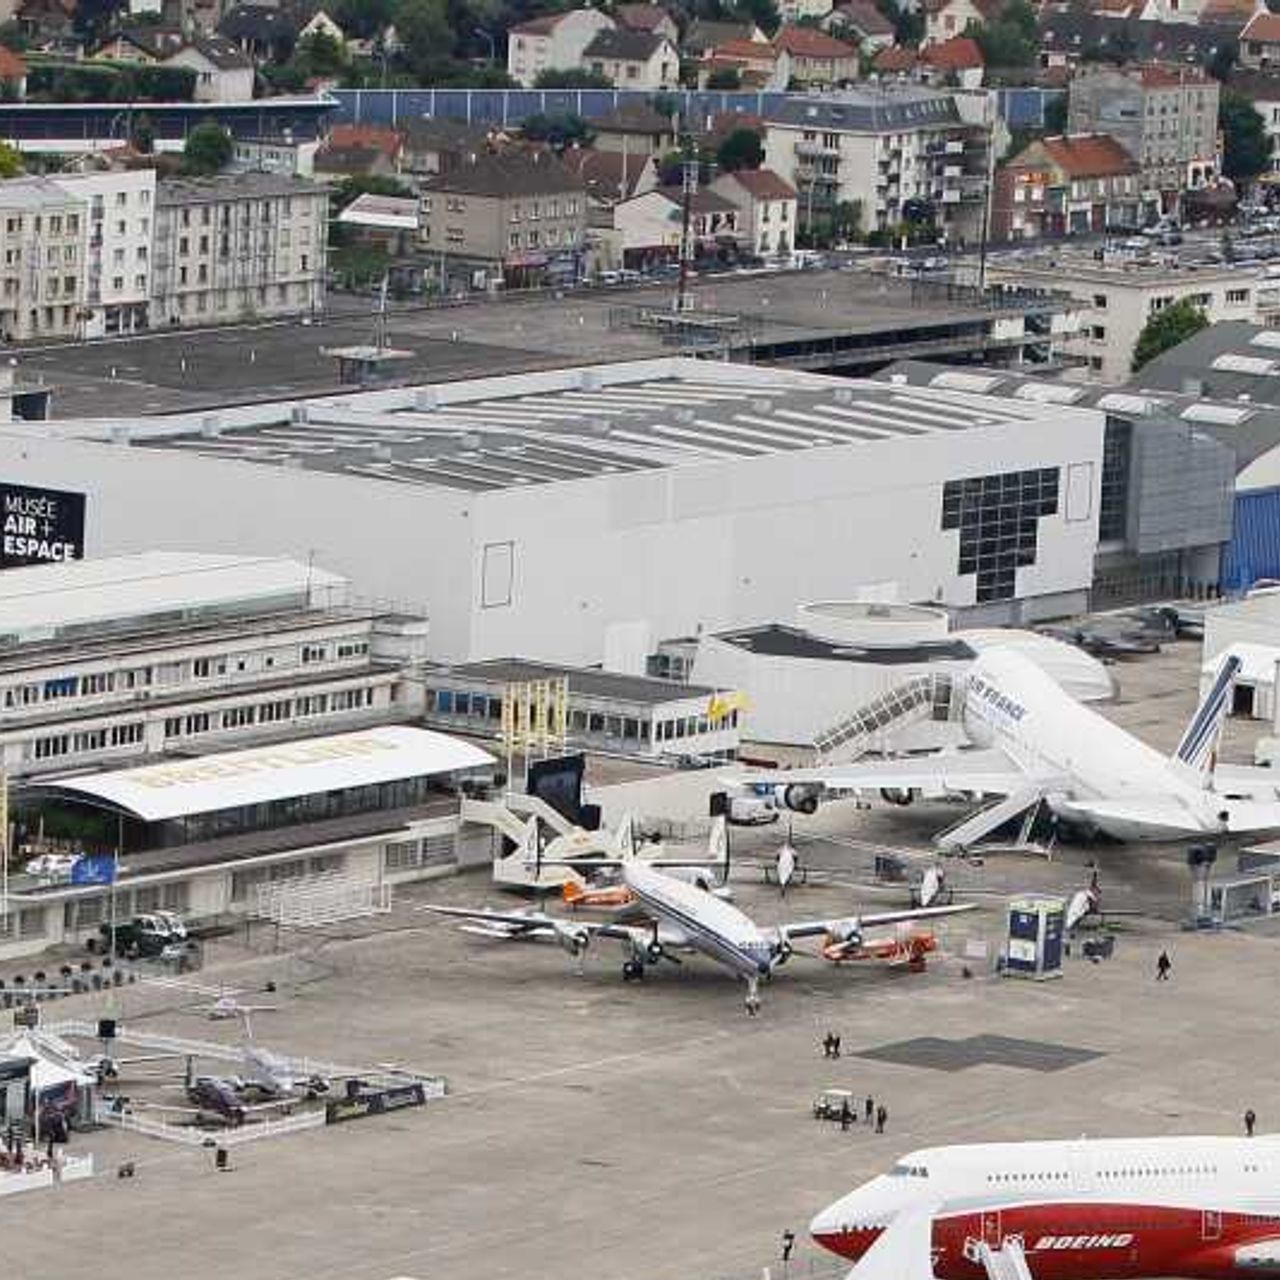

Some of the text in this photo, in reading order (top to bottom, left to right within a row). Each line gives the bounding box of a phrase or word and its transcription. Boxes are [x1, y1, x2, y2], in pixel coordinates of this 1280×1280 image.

[5, 495, 57, 519] MUSÉE
[4, 514, 37, 535] AIR
[4, 535, 75, 561] ESPACE
[1034, 1233, 1135, 1250] BOEING
